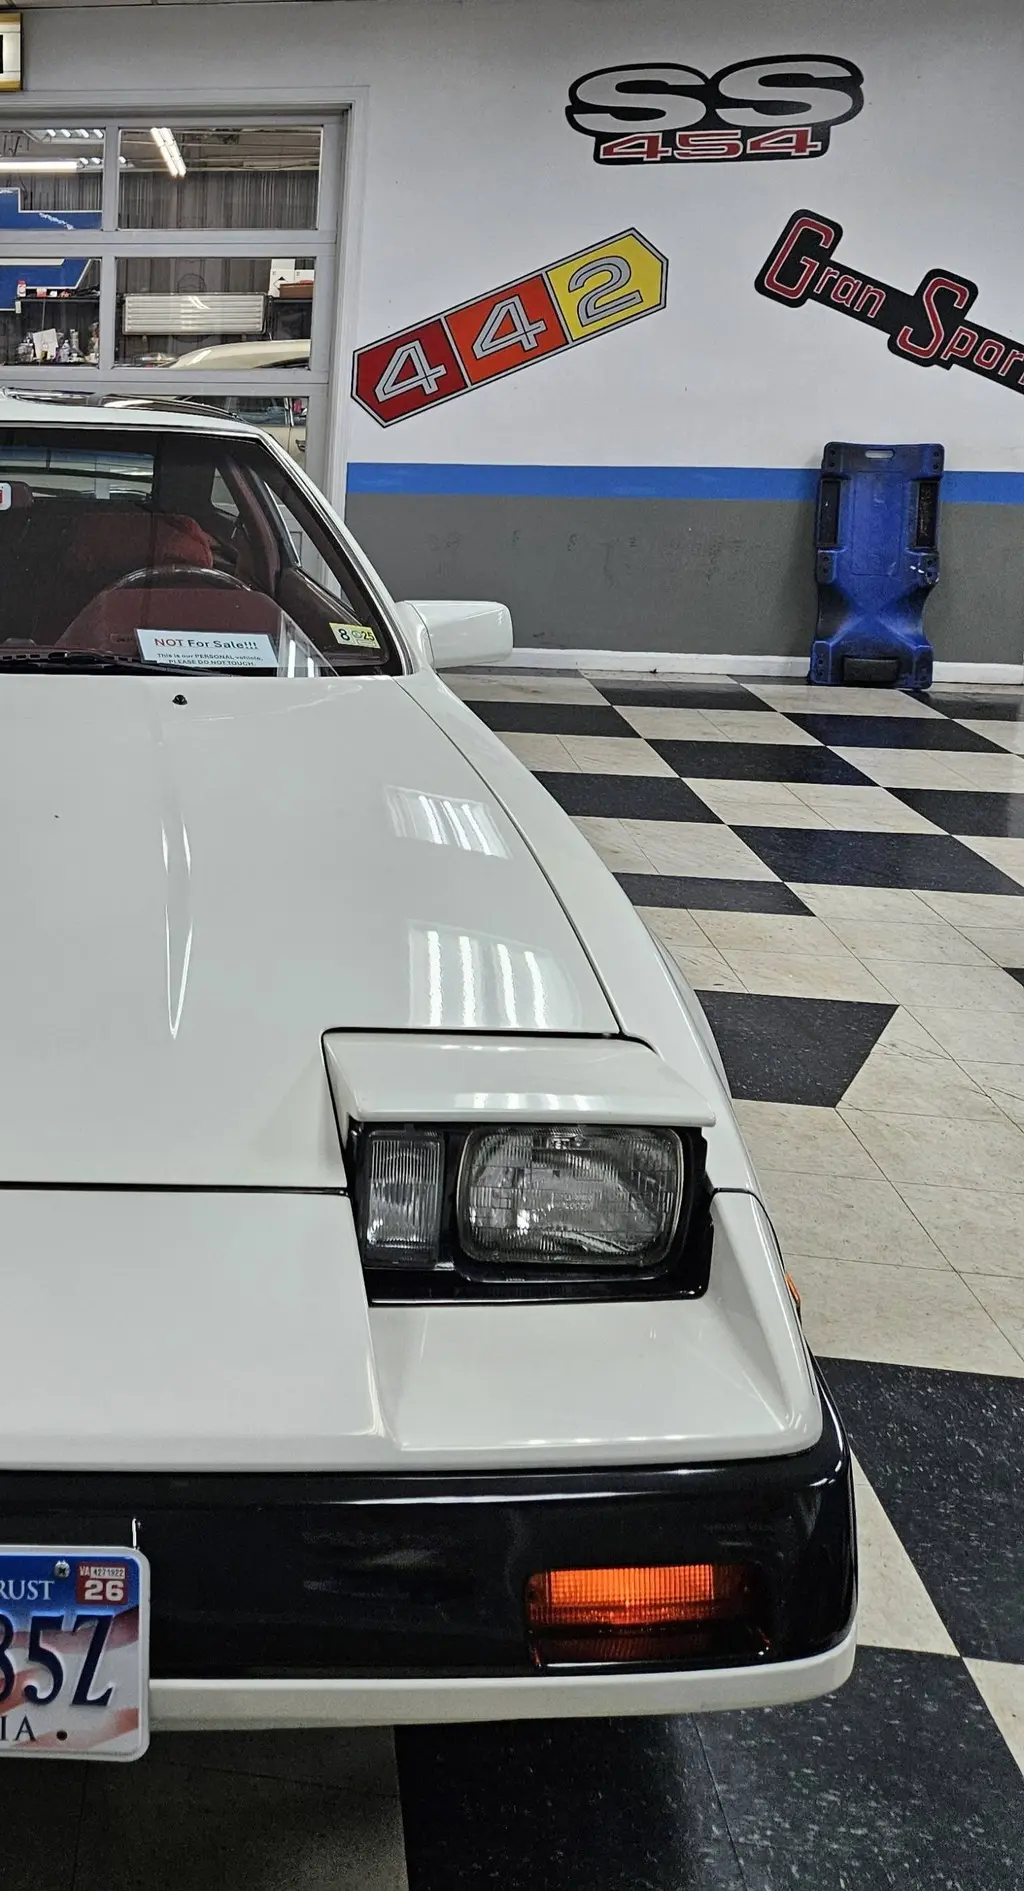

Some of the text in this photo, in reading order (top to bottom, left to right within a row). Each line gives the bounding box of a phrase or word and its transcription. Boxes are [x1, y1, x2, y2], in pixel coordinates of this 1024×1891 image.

[573, 61, 854, 133] SS
[600, 127, 822, 161] 454
[764, 217, 1024, 385] Gran Spor
[154, 638, 258, 650] NOT For Sale!!!
[338, 628, 375, 641] 8 25
[79, 1565, 90, 1576] VA
[84, 1579, 125, 1601] 26
